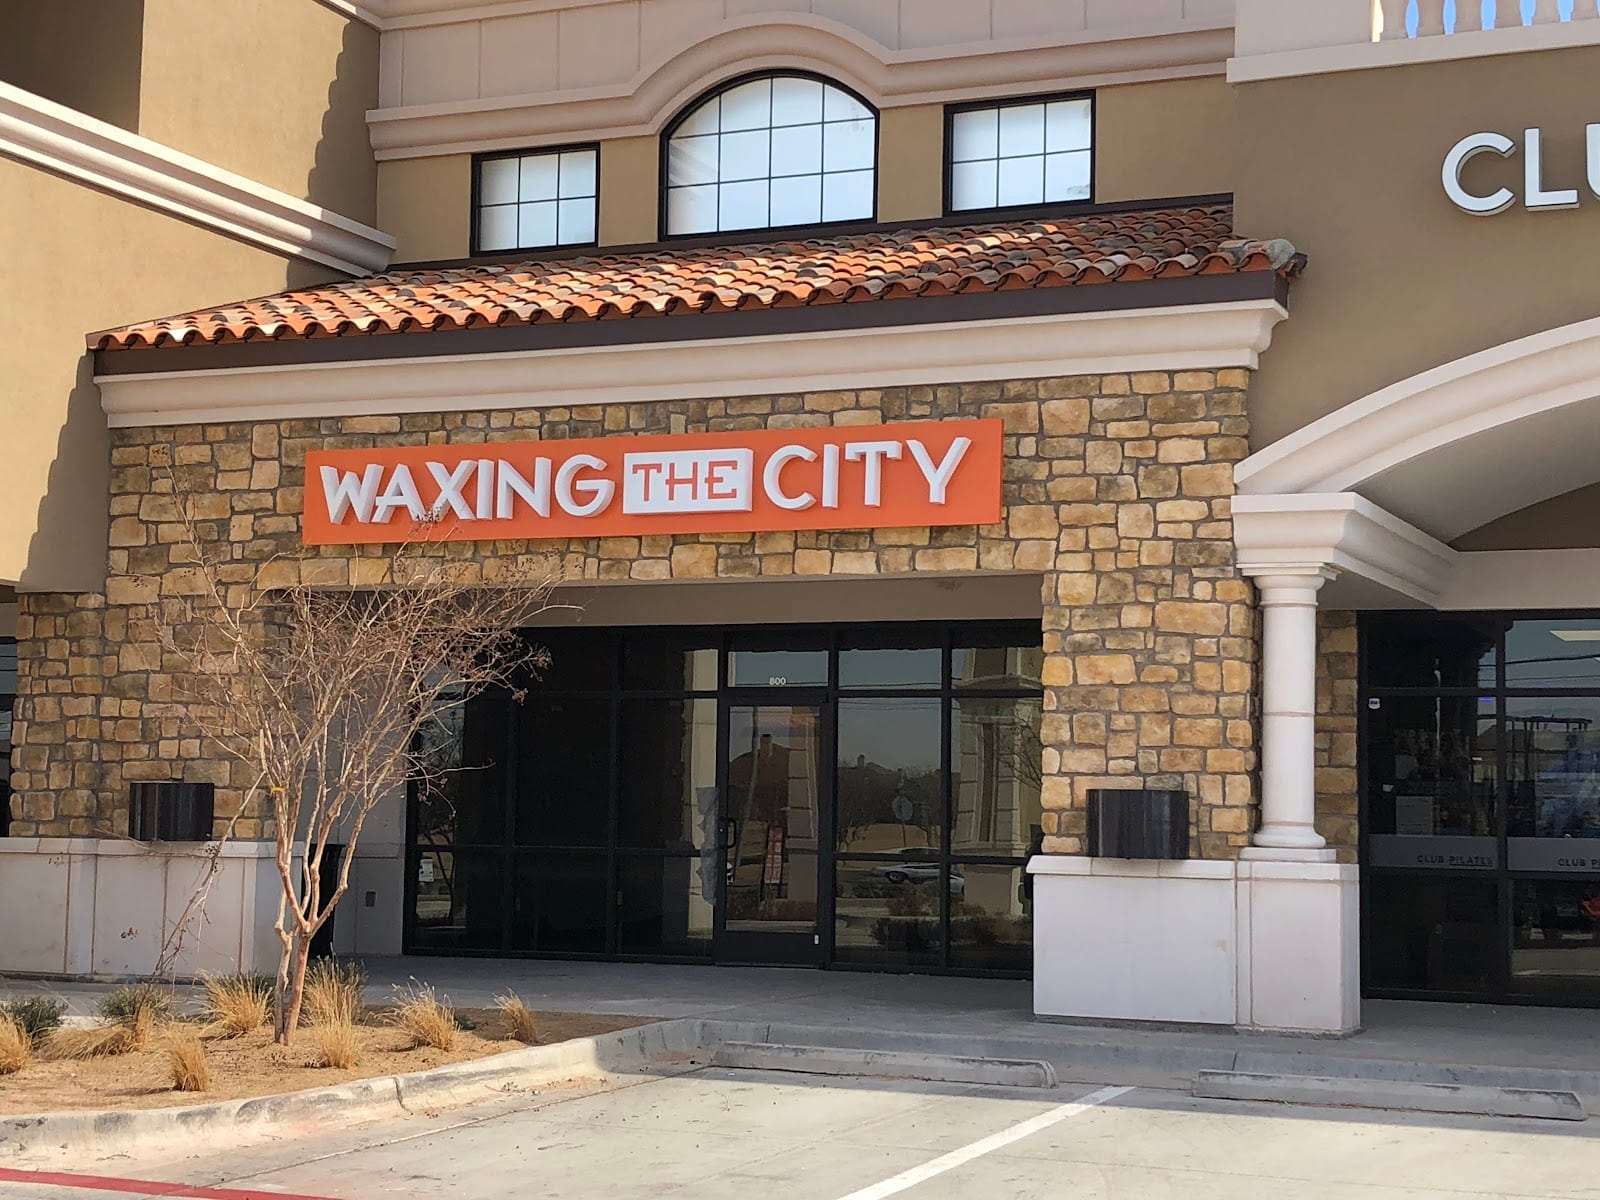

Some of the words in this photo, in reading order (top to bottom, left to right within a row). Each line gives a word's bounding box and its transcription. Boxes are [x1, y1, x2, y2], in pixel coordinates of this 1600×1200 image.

[1441, 122, 1600, 217] CL
[319, 454, 615, 524] WAXING
[632, 460, 737, 502] THE
[763, 437, 972, 511] CITY
[769, 676, 786, 686] 800
[1416, 855, 1445, 865] CLUB
[1450, 855, 1493, 866] PILATES
[1557, 858, 1586, 867] CLUB
